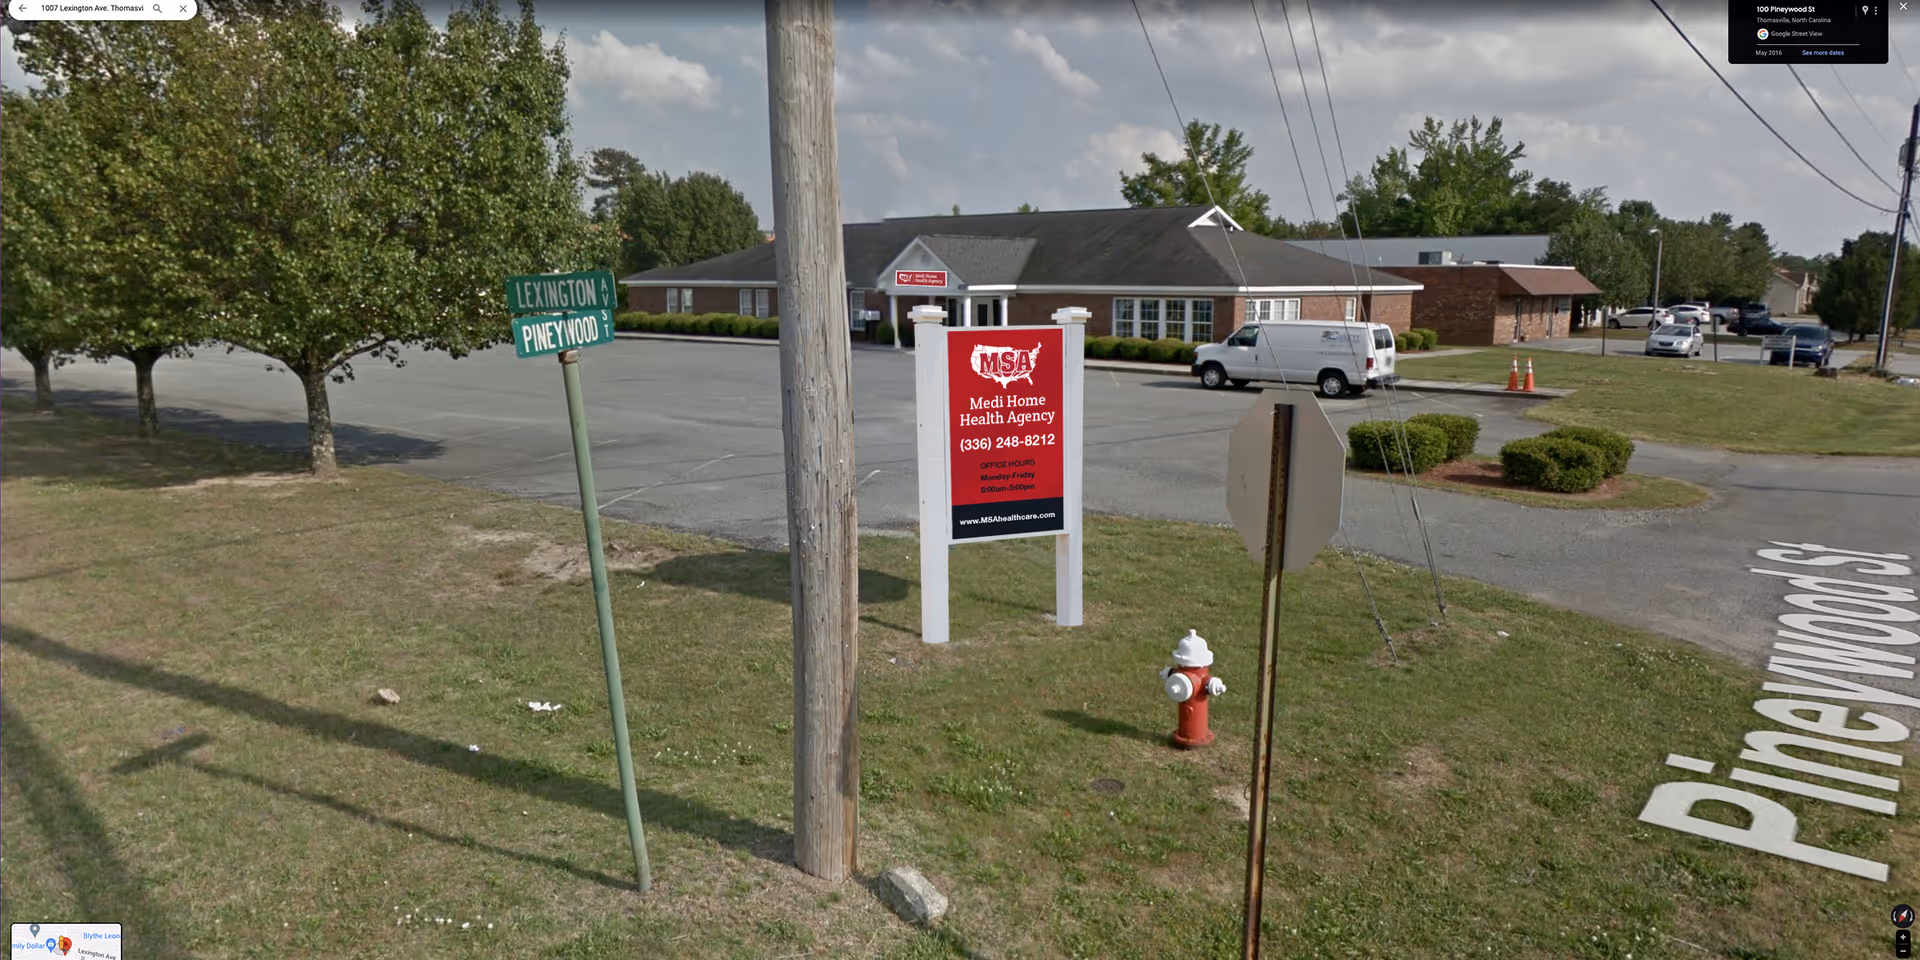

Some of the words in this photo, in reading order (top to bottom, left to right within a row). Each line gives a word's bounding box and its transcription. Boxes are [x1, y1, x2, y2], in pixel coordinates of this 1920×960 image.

[516, 279, 597, 308] LEXINGTON
[522, 316, 599, 353] PINEYWOOD
[980, 351, 1032, 373] MSA
[970, 395, 1004, 410] Medi
[1007, 395, 1046, 408] Home
[960, 412, 1004, 427] Health
[1007, 411, 1056, 426] Agency
[960, 437, 992, 453] (336)
[996, 434, 1055, 449] 248-8212
[980, 461, 1007, 469] OFFICE
[1009, 459, 1036, 468] HOURS
[981, 472, 1035, 481] Monday-Friday
[981, 484, 1035, 493] 8:00am-5:00pm
[960, 512, 1056, 525] www.MSAhealthcare.com
